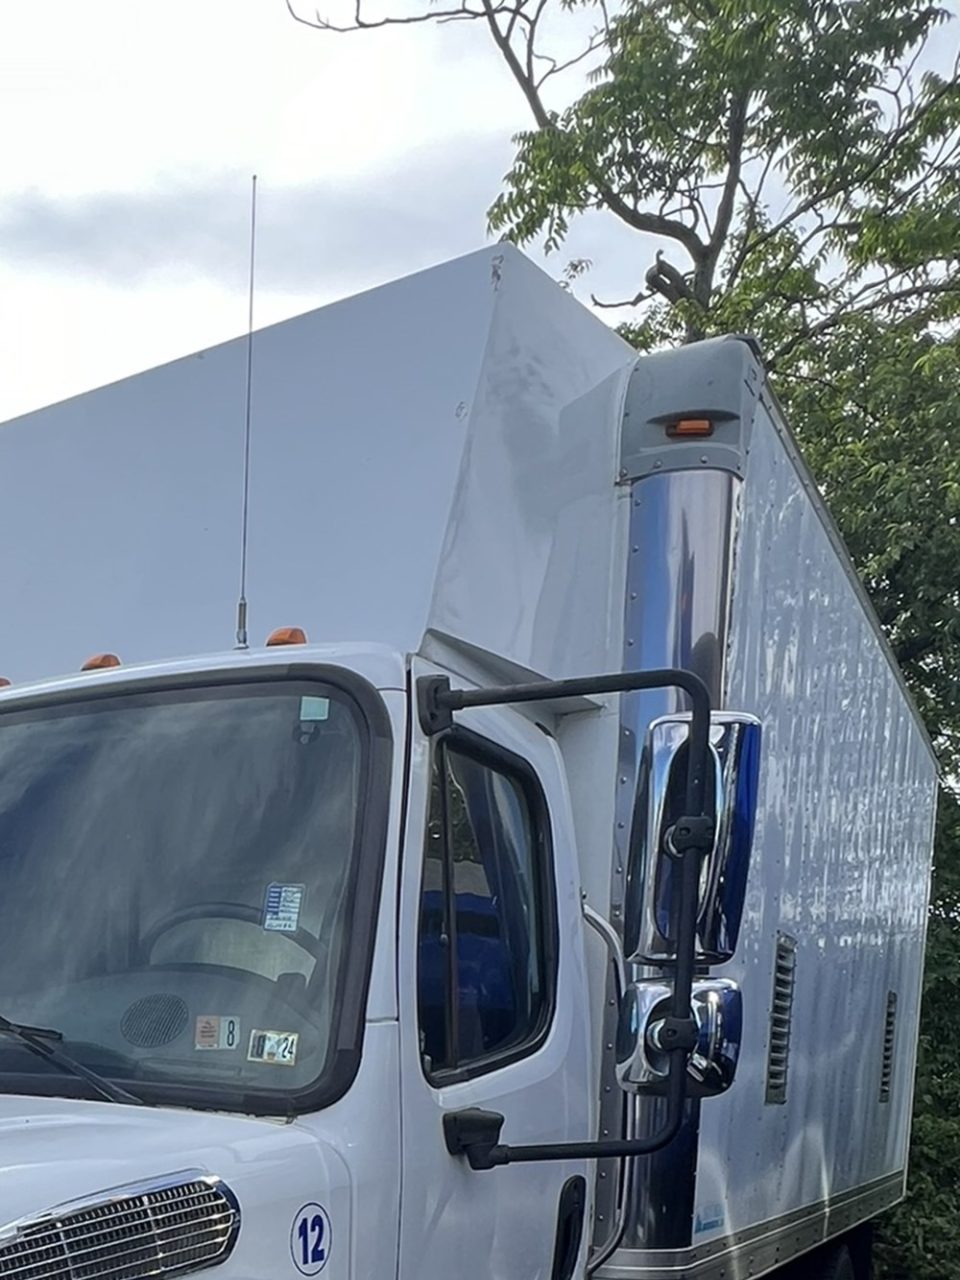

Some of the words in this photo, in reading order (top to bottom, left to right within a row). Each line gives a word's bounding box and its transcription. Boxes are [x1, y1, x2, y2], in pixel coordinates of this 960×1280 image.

[227, 1019, 235, 1047] 8
[281, 1036, 295, 1059] 24
[298, 1214, 325, 1265] 12
